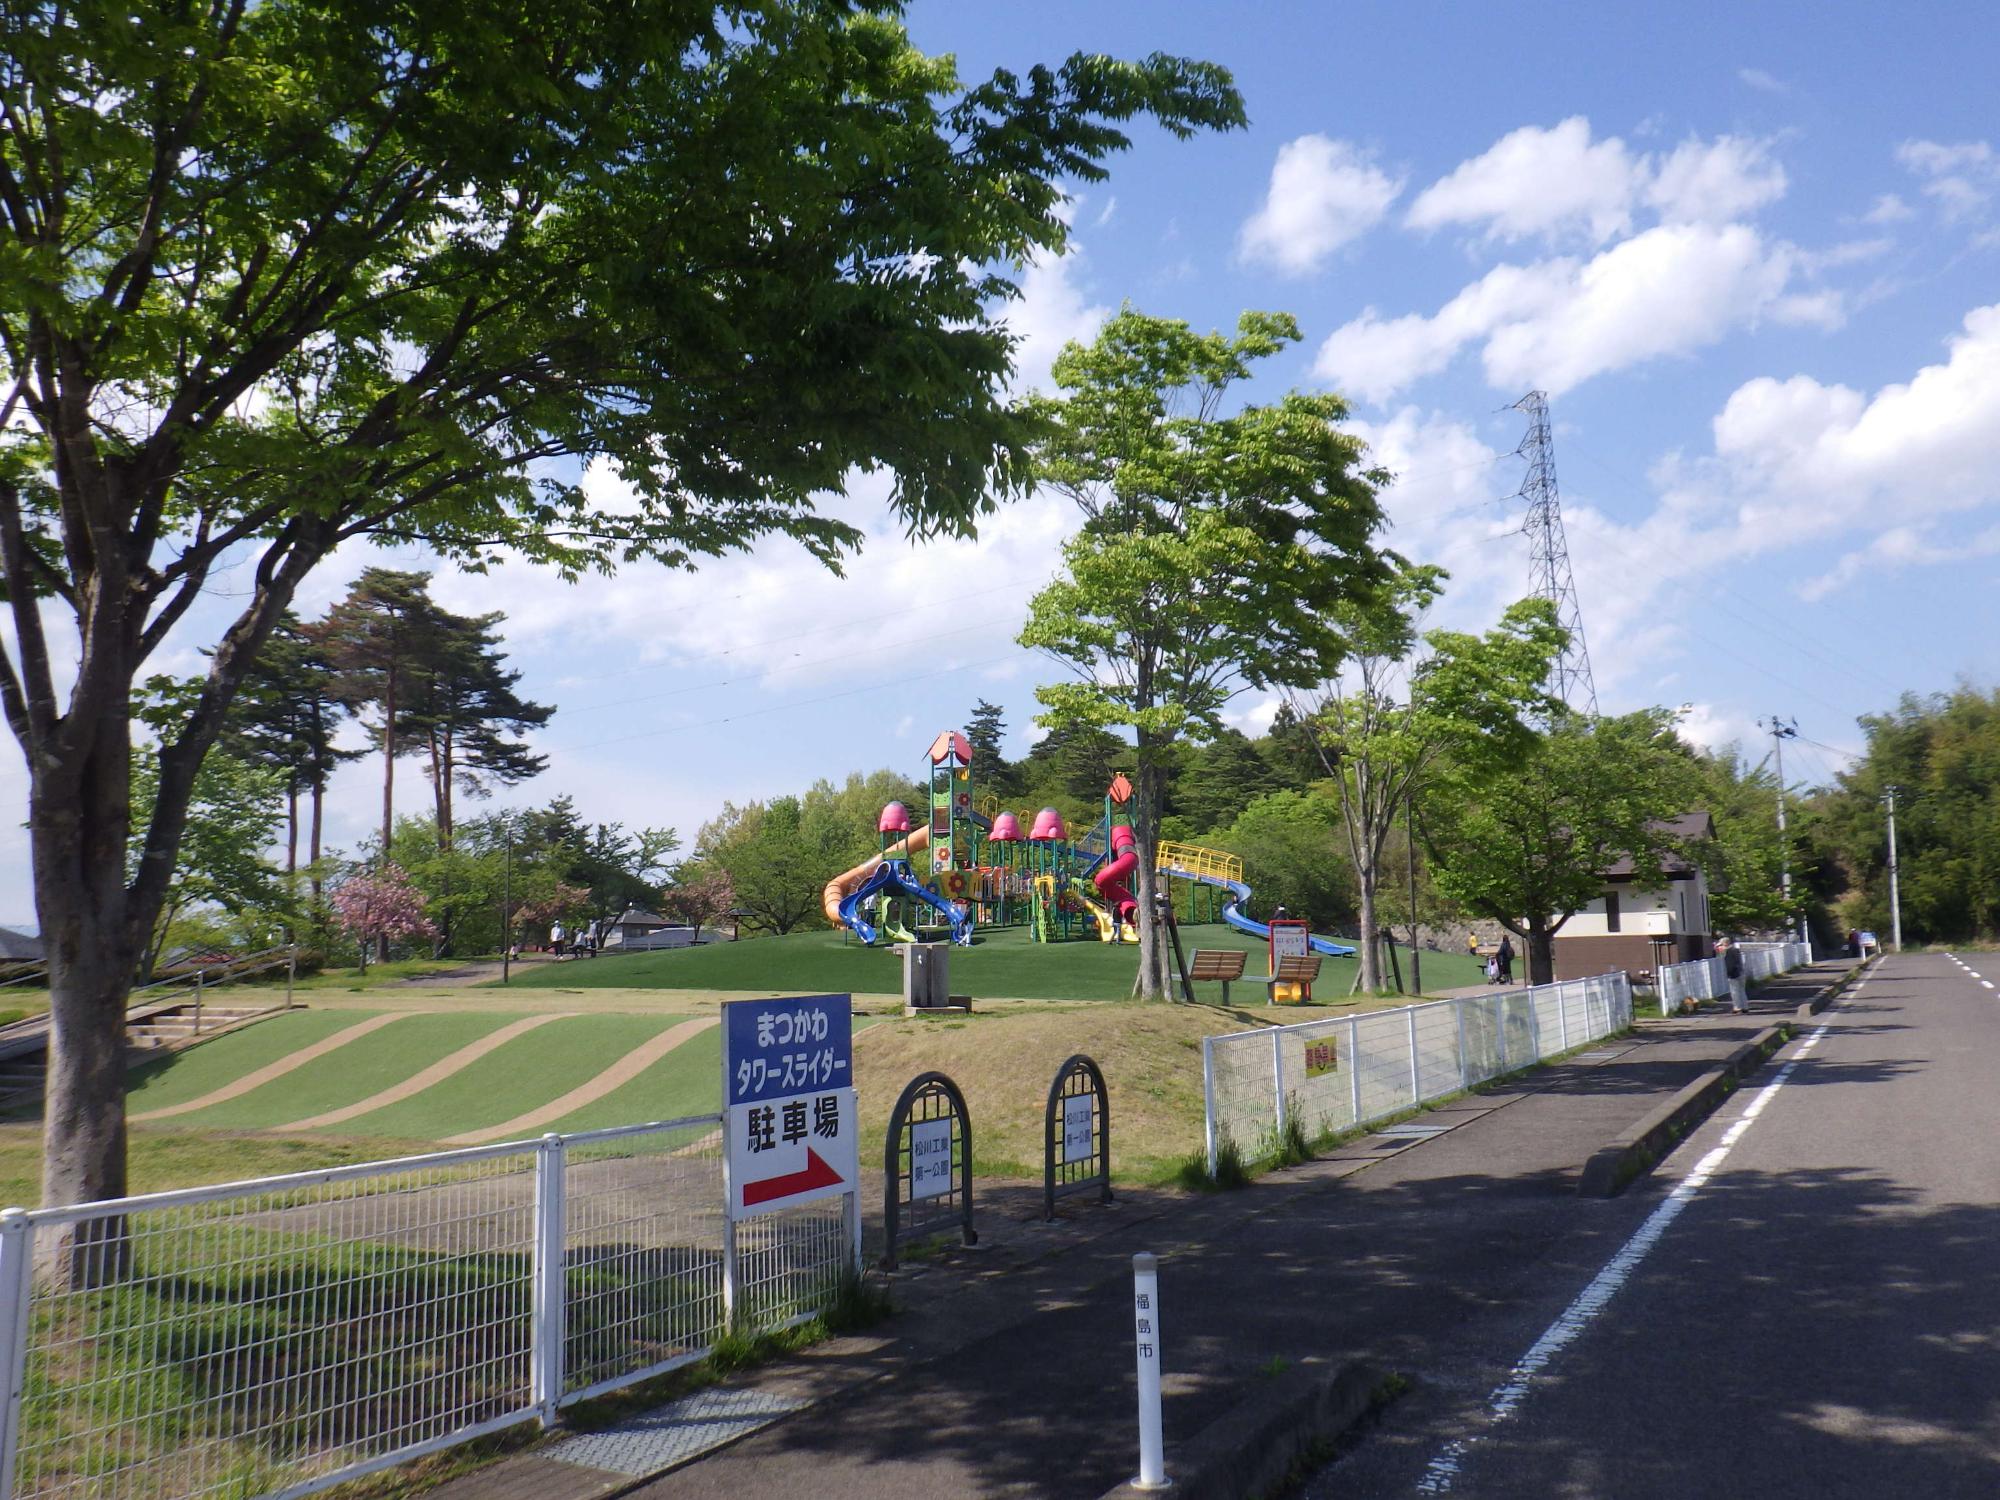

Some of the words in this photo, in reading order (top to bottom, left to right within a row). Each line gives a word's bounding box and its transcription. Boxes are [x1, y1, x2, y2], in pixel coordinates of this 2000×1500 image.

[757, 1008, 828, 1048] まつかわ
[737, 1048, 846, 1096] タワースライダー
[747, 1096, 839, 1153] 駐車場
[914, 1137, 949, 1156] 松川工業
[914, 1160, 949, 1182] 第一公園
[1136, 1293, 1153, 1359] 福島市
